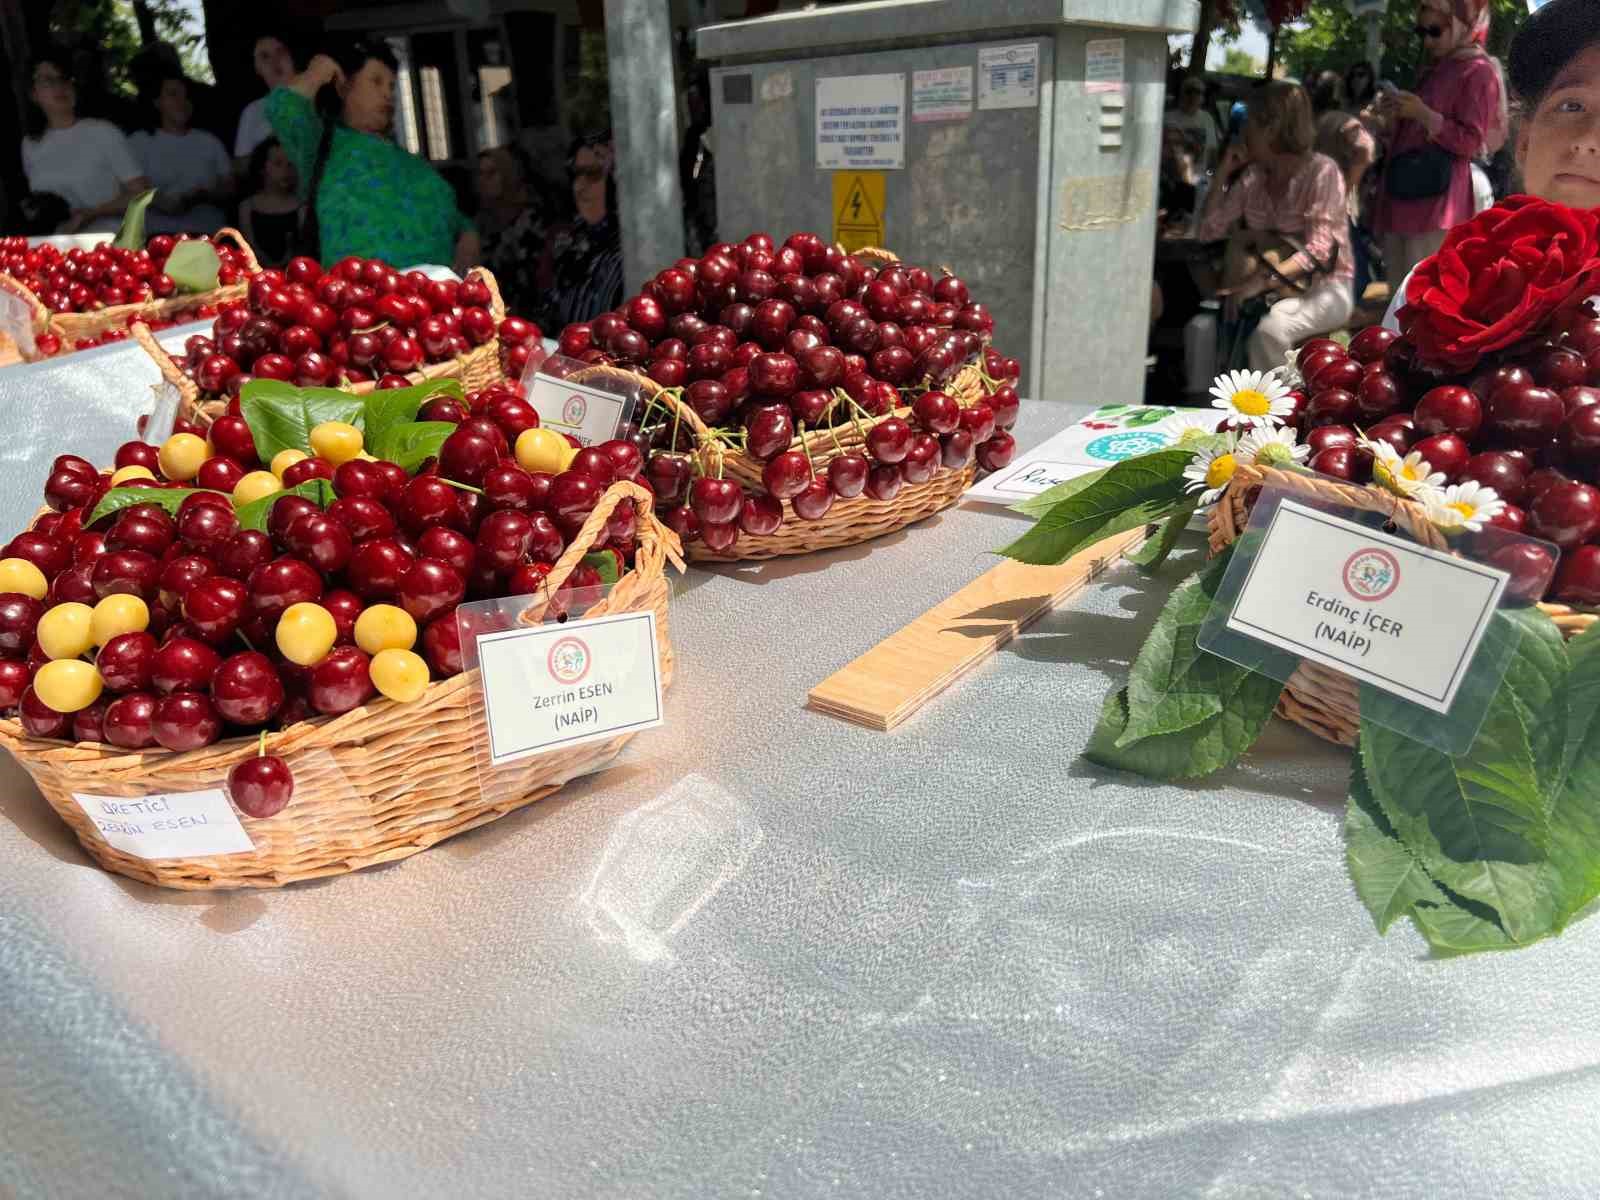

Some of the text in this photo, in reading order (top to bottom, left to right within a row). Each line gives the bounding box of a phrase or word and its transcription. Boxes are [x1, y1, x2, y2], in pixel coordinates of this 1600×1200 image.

[1306, 591, 1403, 637] Erdinç İÇER
[1315, 621, 1371, 656] (NAİP)
[533, 682, 612, 709] Zerrin ESEN
[555, 706, 598, 731] (NAİP)
[152, 813, 207, 830] ESEN
